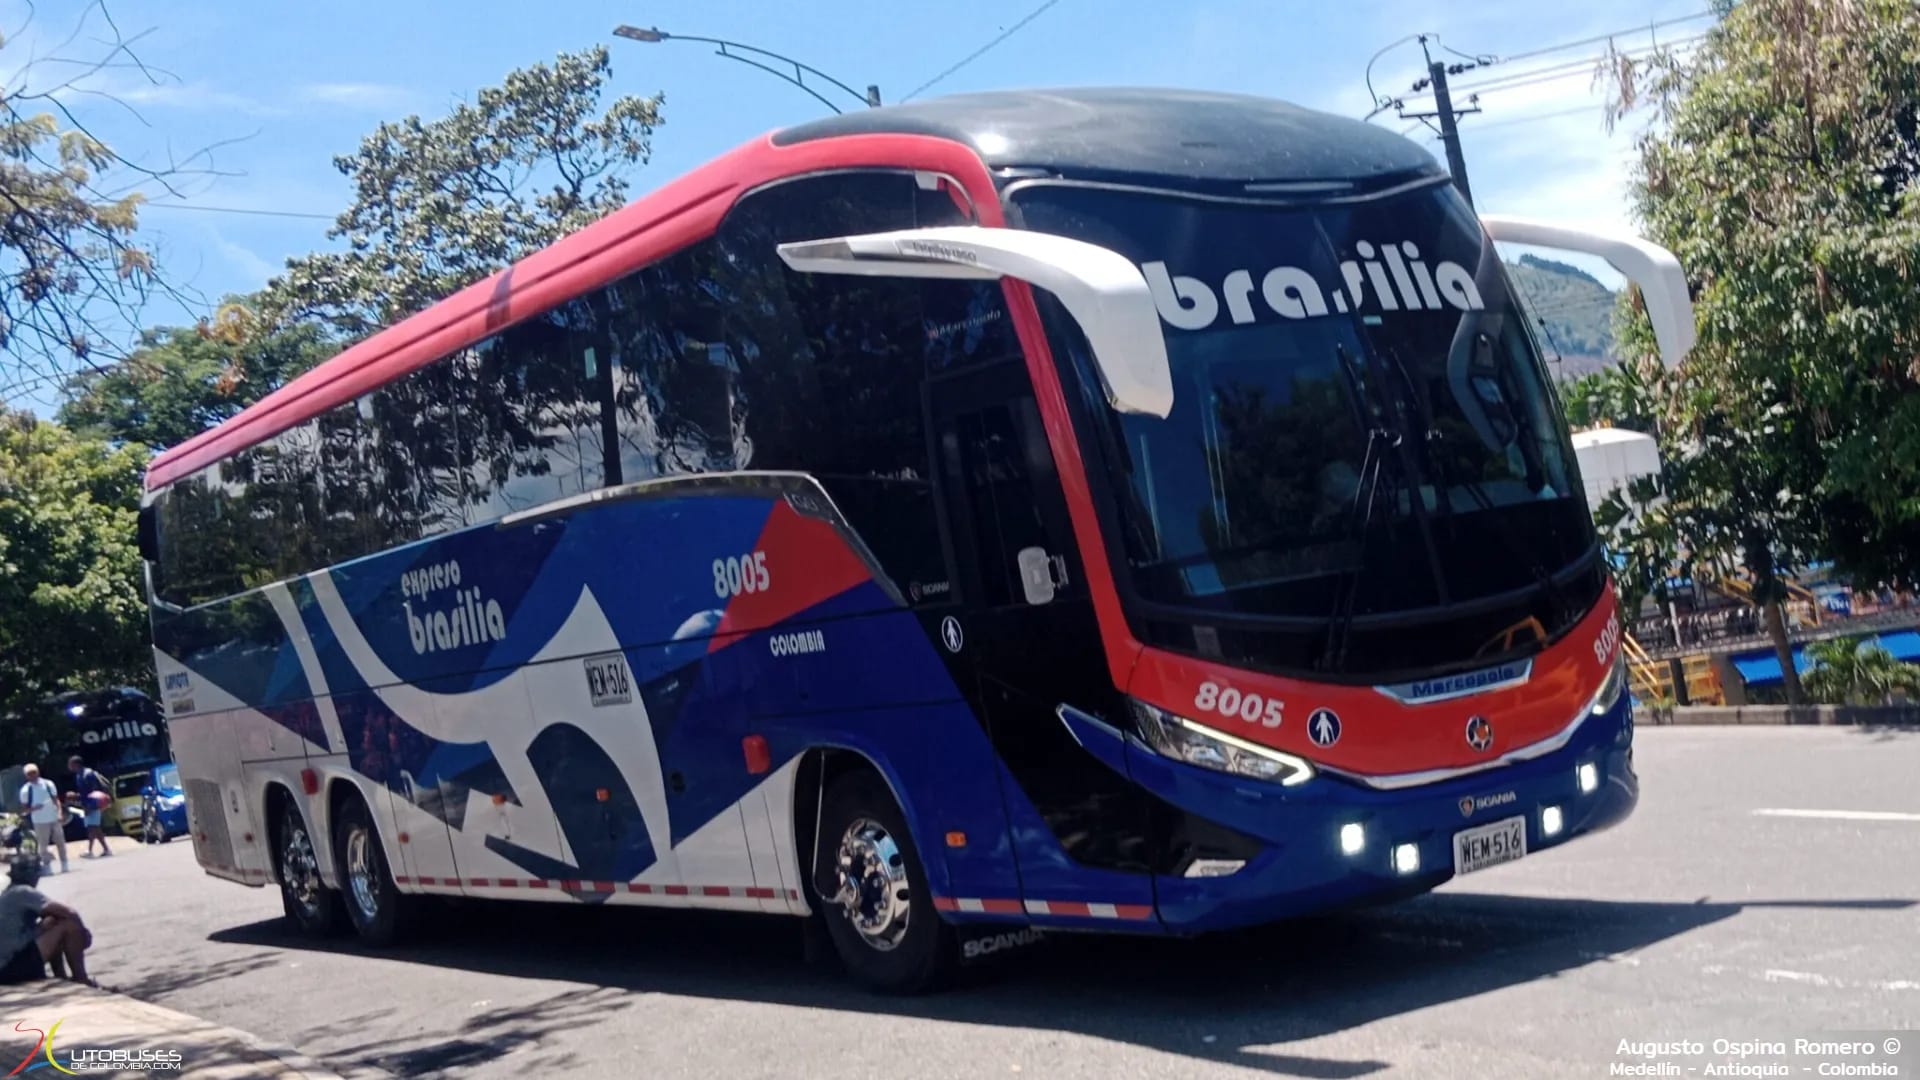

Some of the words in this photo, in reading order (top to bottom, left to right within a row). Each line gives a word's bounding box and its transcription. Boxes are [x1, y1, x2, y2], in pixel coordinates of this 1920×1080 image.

[1141, 240, 1485, 331] brasilia
[401, 559, 461, 602] expreso
[712, 551, 770, 599] 8005
[403, 585, 506, 655] brasilia
[770, 629, 825, 657] COLOMBIA
[1594, 609, 1619, 665] 8005
[1194, 681, 1286, 729] 8005
[1412, 667, 1515, 698] Marcopolo
[1476, 791, 1517, 810] SCANIA
